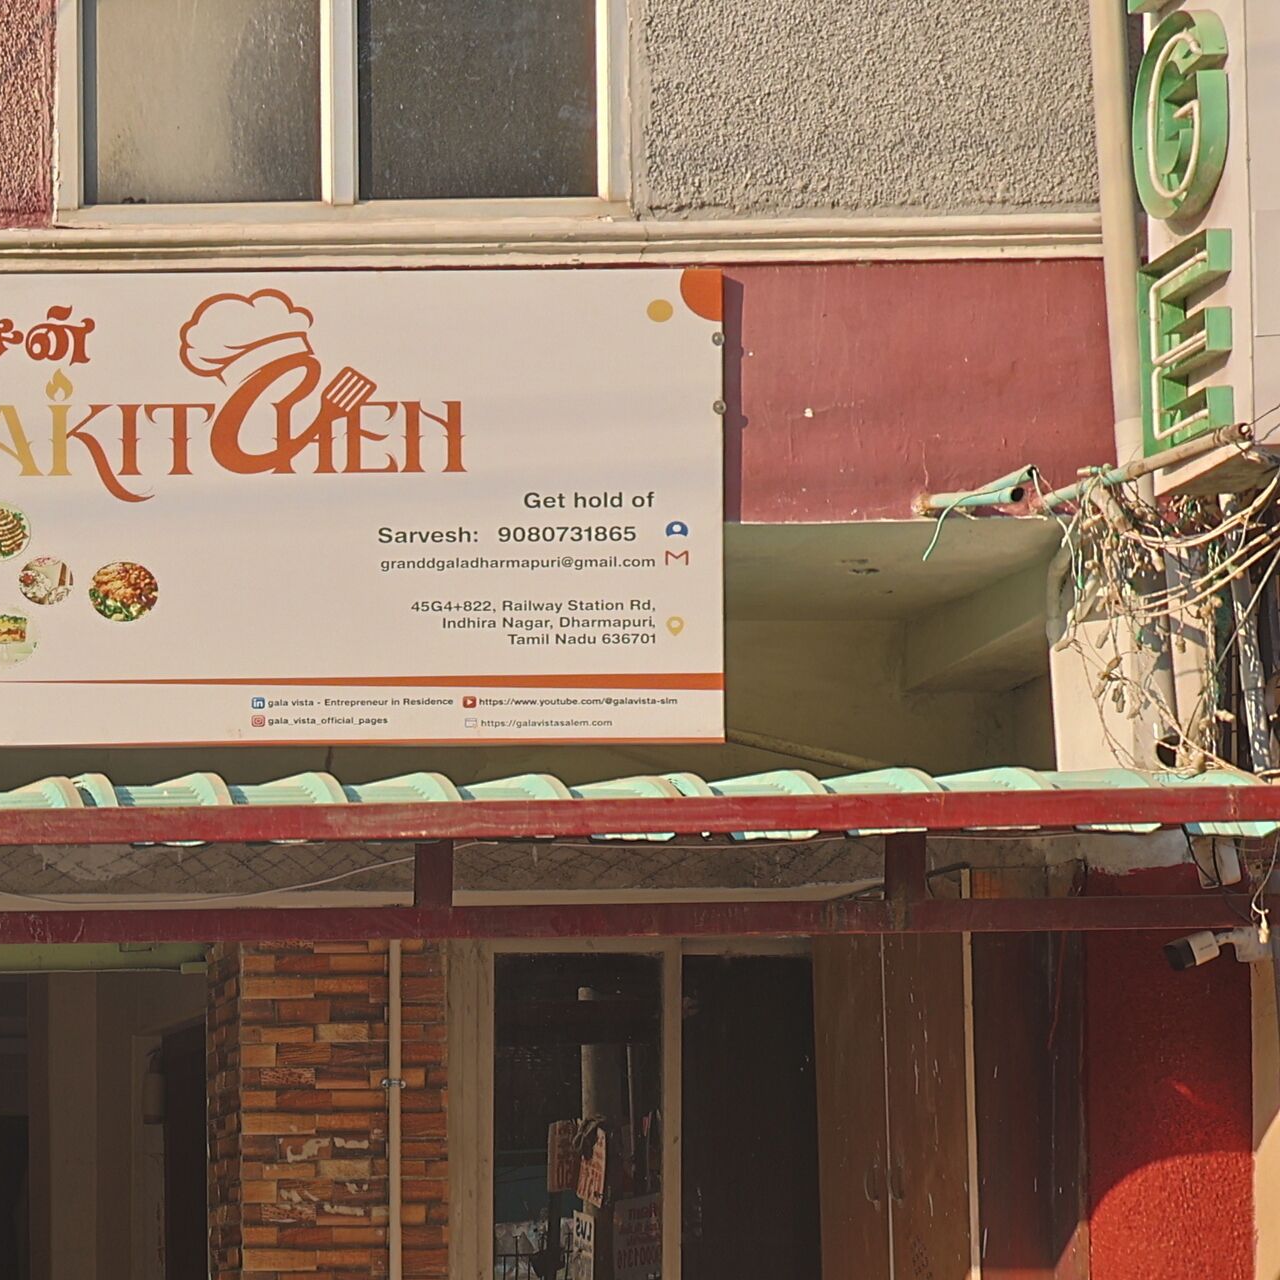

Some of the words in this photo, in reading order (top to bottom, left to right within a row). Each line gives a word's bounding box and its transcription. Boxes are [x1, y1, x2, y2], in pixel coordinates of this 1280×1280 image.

[523, 492, 566, 509] Get
[573, 491, 624, 508] hold
[631, 490, 655, 508] of
[378, 526, 479, 544] Sarvesh:
[497, 525, 638, 543] 9080731865
[380, 555, 656, 572] granddgaladharmapuri@gmail.com
[410, 600, 497, 614] 45G4+822,
[501, 599, 563, 614] Railway
[567, 599, 624, 612] Station
[630, 598, 656, 613] Rd,
[442, 616, 497, 629] Indhira
[502, 616, 554, 631] Nagar,
[559, 615, 656, 630] Dharmapuri,
[507, 633, 550, 645] Tamil
[555, 633, 597, 645] Nadu
[601, 632, 657, 645] 636701
[268, 699, 289, 708] gala
[291, 698, 314, 707] vista
[324, 698, 389, 708] Entrepreneur
[391, 697, 400, 706] in
[403, 697, 454, 706] Residence
[268, 716, 388, 727] gala_vista_official_pages
[481, 718, 613, 729] https://galavistasalem.com
